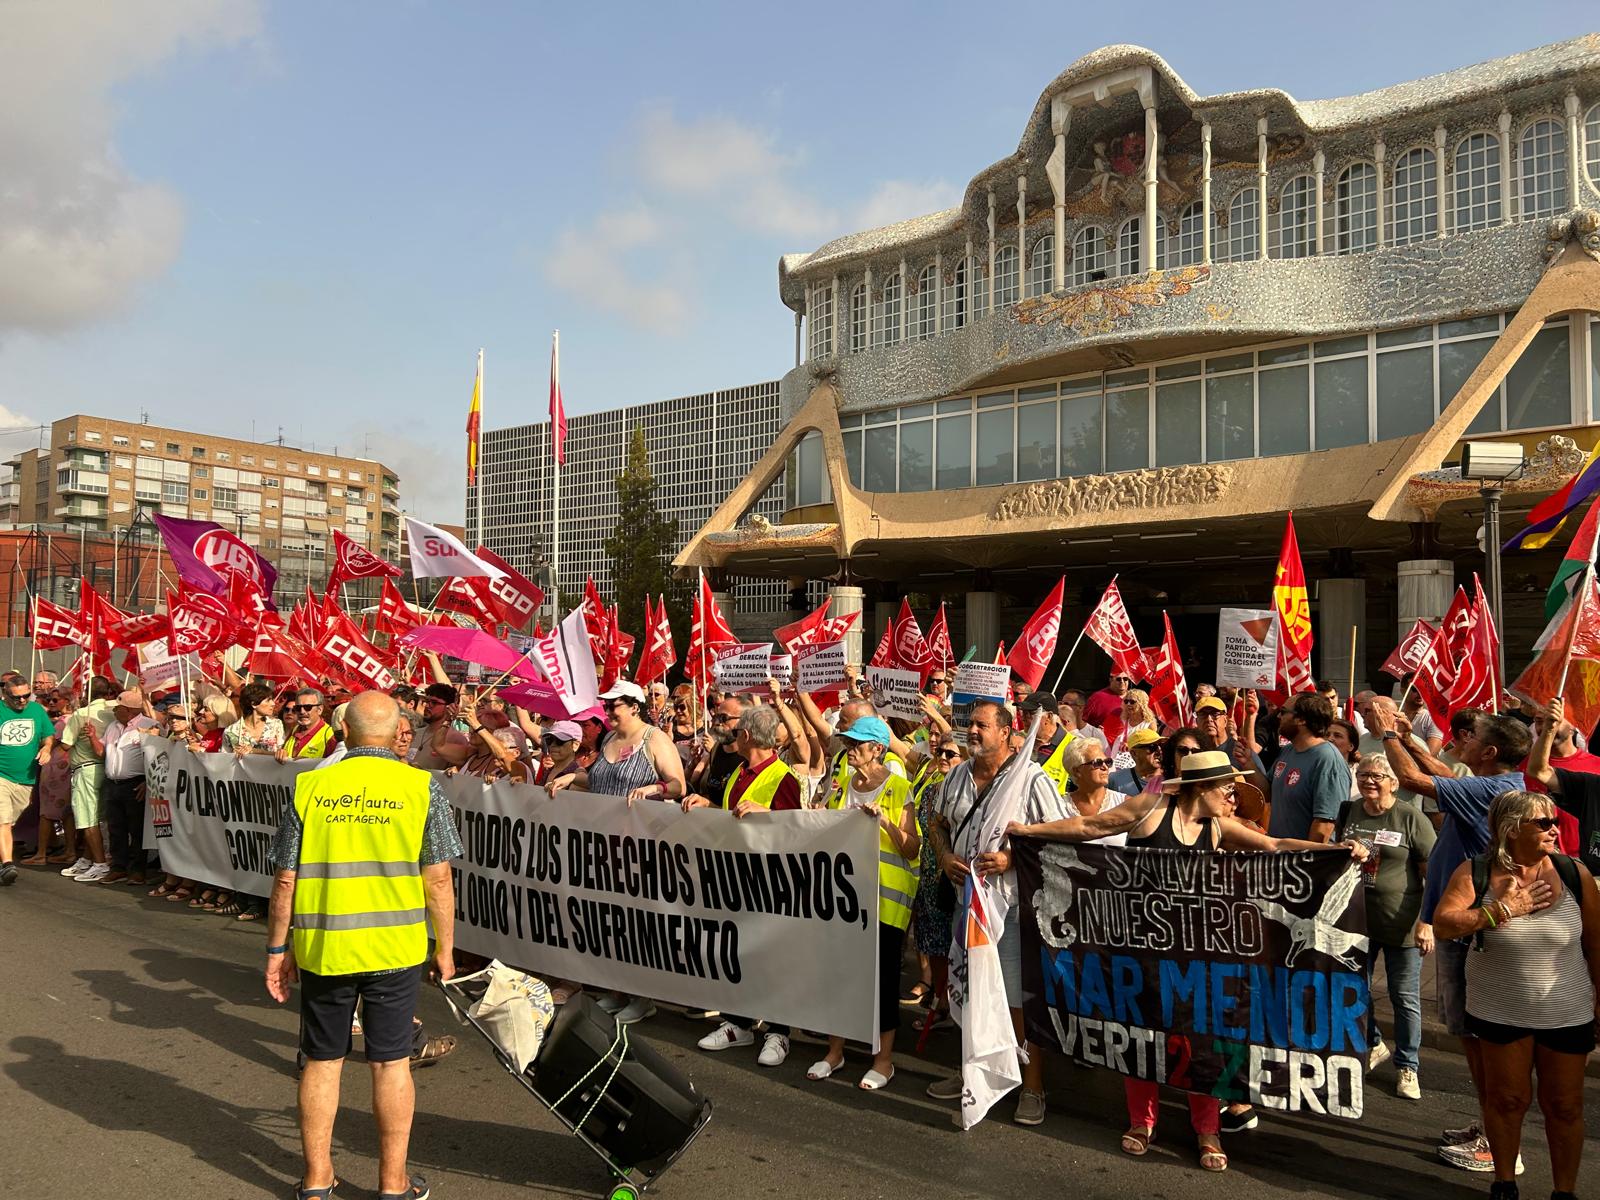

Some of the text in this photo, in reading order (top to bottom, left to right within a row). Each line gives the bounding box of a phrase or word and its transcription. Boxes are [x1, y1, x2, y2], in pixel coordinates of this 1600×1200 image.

[174, 608, 217, 635] UGT
[1226, 637, 1247, 645] TOMA
[719, 648, 735, 660] UGT
[1225, 644, 1257, 652] PARTIDO
[816, 651, 844, 660] DERECHA
[1224, 651, 1256, 660] CONTRA
[806, 661, 844, 669] ULTRADERECHA
[1224, 658, 1263, 667] FASCISMO
[884, 677, 919, 691] NO SOBRAN
[890, 695, 919, 706] SOBRAN
[326, 815, 391, 825] CARTAGENA
[465, 811, 525, 875] TODOS
[526, 822, 562, 884] LOS
[567, 828, 695, 906] DERECHOS
[695, 847, 867, 931] HUMANOS,
[1104, 848, 1314, 903] SALVEMOS
[467, 872, 509, 936] ODIO
[511, 884, 523, 939] Y
[527, 888, 569, 949] DEL
[567, 895, 741, 984] SUFRIMIENTO
[1077, 888, 1264, 957] NUESTRO
[1040, 945, 1369, 1054] MAR MENOR
[1048, 1006, 1364, 1120] VERTI2 ZERO
